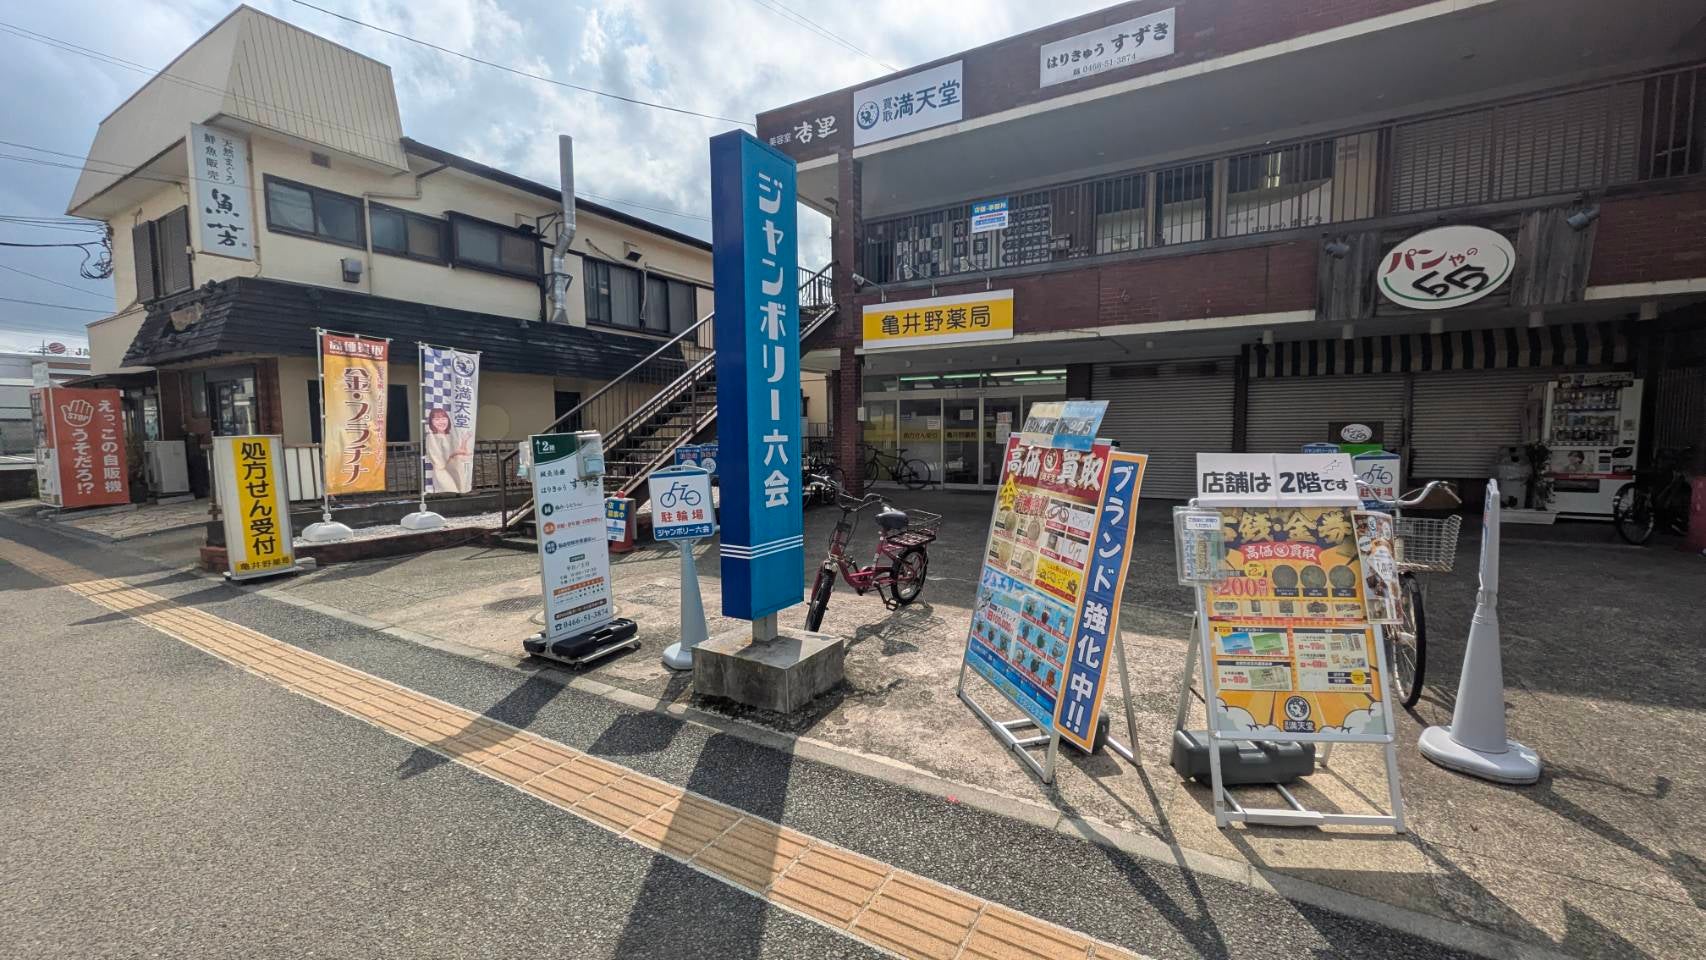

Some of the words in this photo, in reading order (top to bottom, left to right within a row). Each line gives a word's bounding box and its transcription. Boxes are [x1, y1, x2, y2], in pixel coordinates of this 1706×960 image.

[1047, 43, 1105, 69] はりきゅう
[1111, 22, 1168, 53] すずき
[894, 80, 960, 119] 満天堂
[204, 133, 219, 180] 鮮魚販売
[769, 133, 791, 146] 美容室
[222, 138, 235, 184] 天然まぐろ
[1386, 247, 1478, 274] パンやの
[758, 172, 789, 509] ジャンボリー六会
[882, 305, 990, 336] 亀井野薬局
[343, 367, 372, 486] 金・プラチナ
[454, 386, 472, 429] 満天堂
[1006, 446, 1042, 478] 高価
[1058, 451, 1105, 491] 買取
[242, 442, 276, 555] 処方せん受付
[661, 508, 704, 523] 駐輪場
[657, 526, 710, 537] ジャンボリー六会
[1246, 545, 1273, 560] 高価
[1290, 544, 1317, 561] 買取
[563, 608, 608, 629] 0466-51-3874
